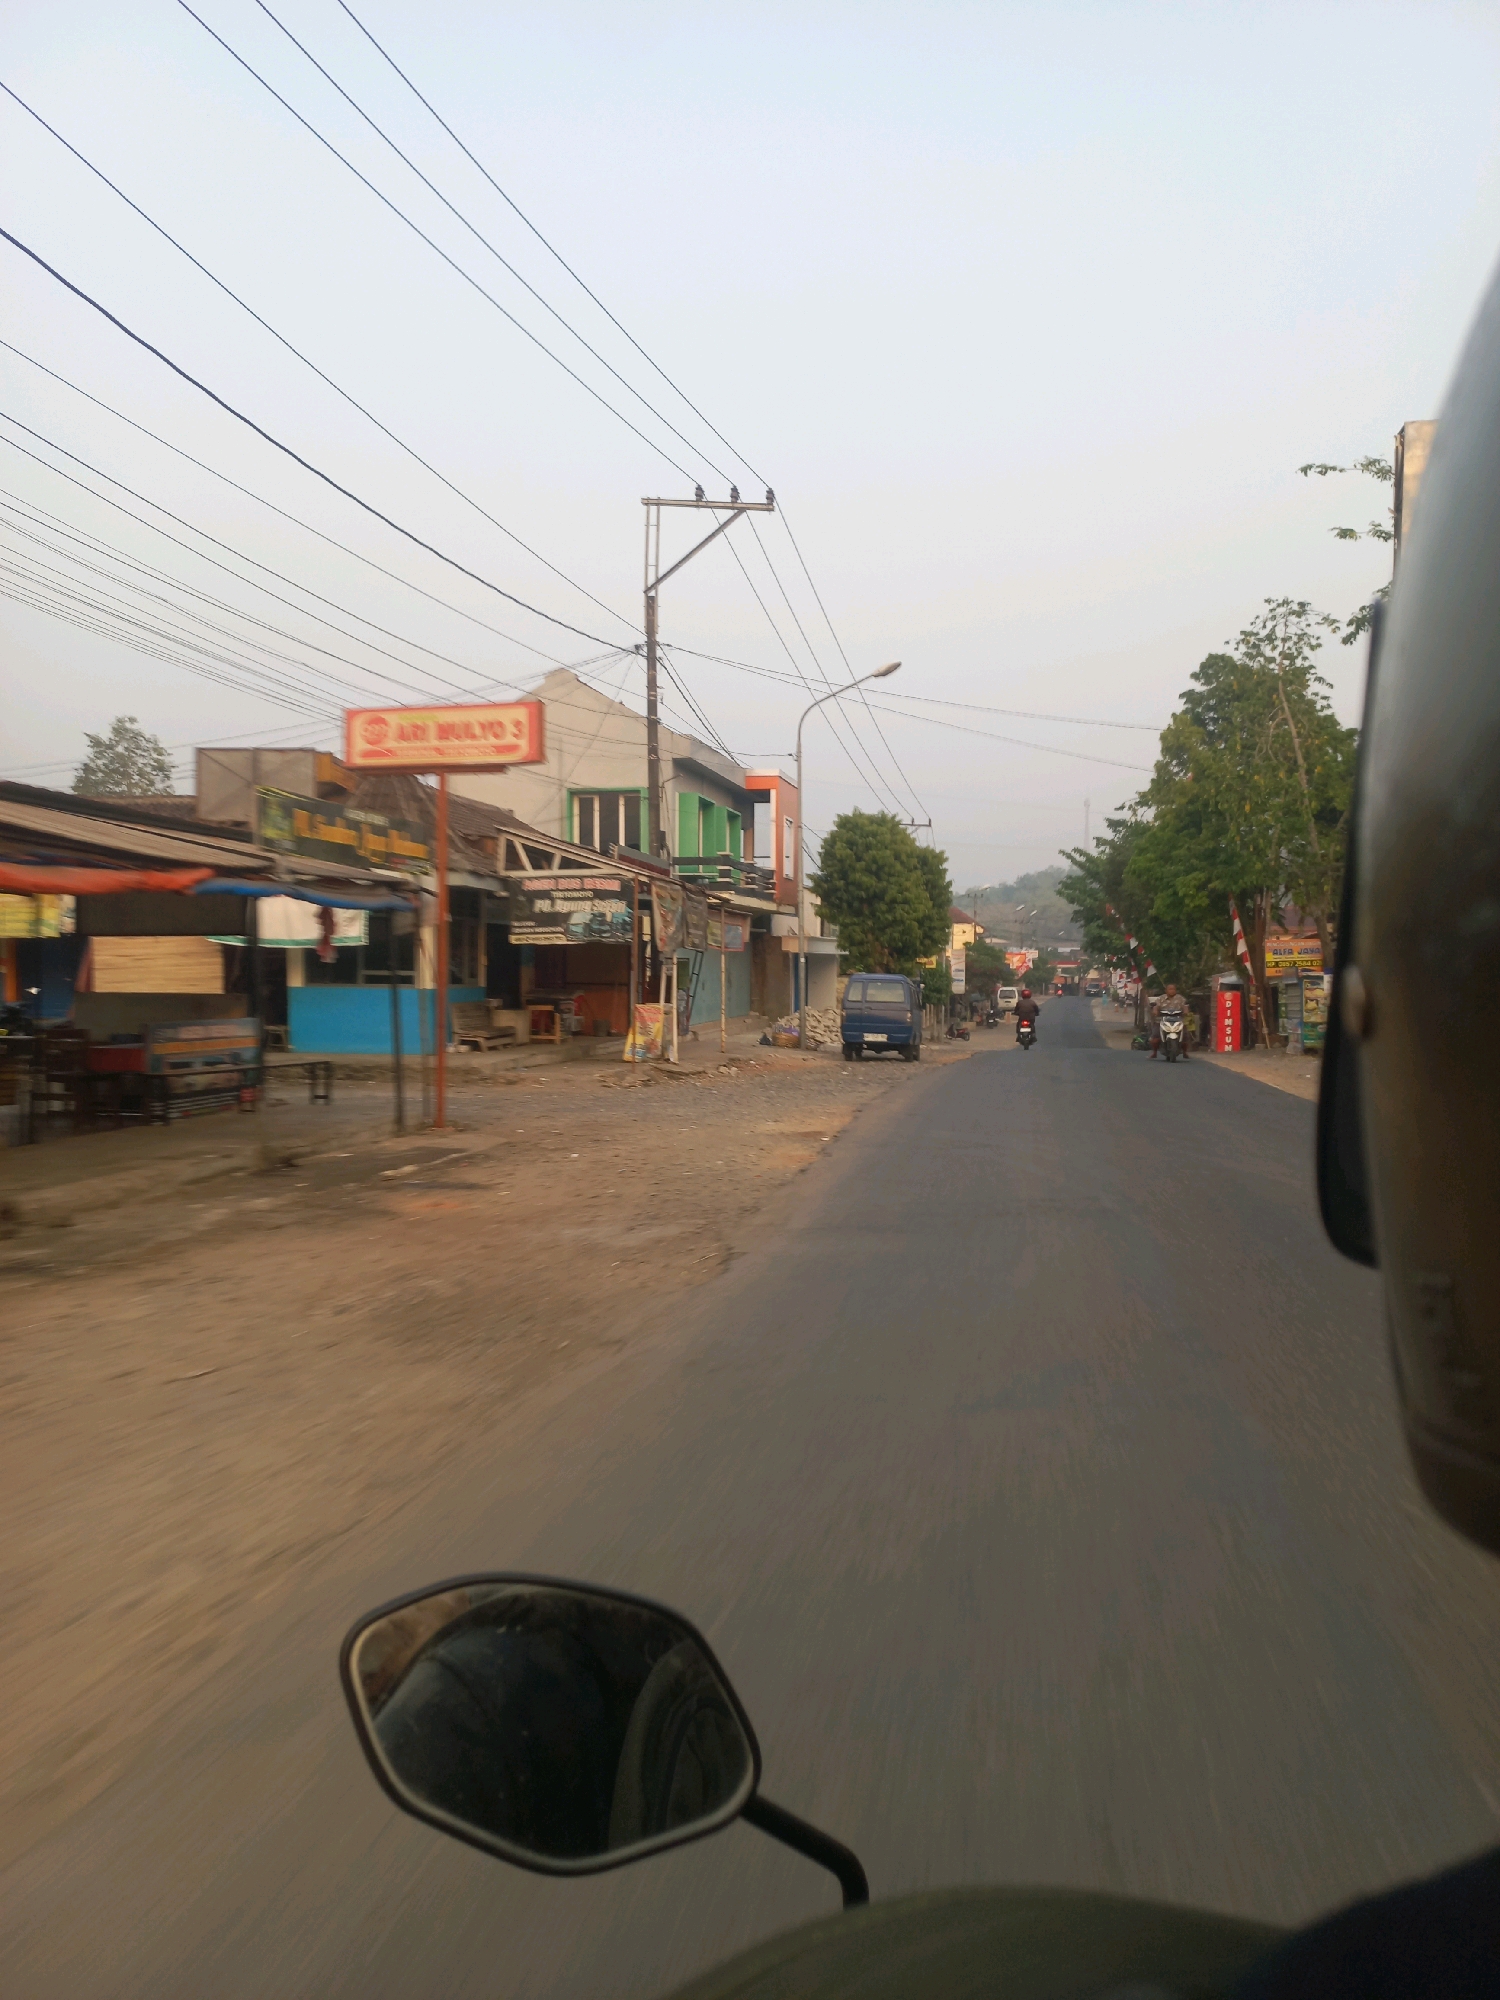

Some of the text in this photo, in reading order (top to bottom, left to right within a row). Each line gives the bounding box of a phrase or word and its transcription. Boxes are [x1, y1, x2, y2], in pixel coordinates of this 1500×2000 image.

[557, 878, 581, 890] BUS
[1297, 947, 1320, 955] JAYA
[1224, 1001, 1233, 1051] DIMSUM
